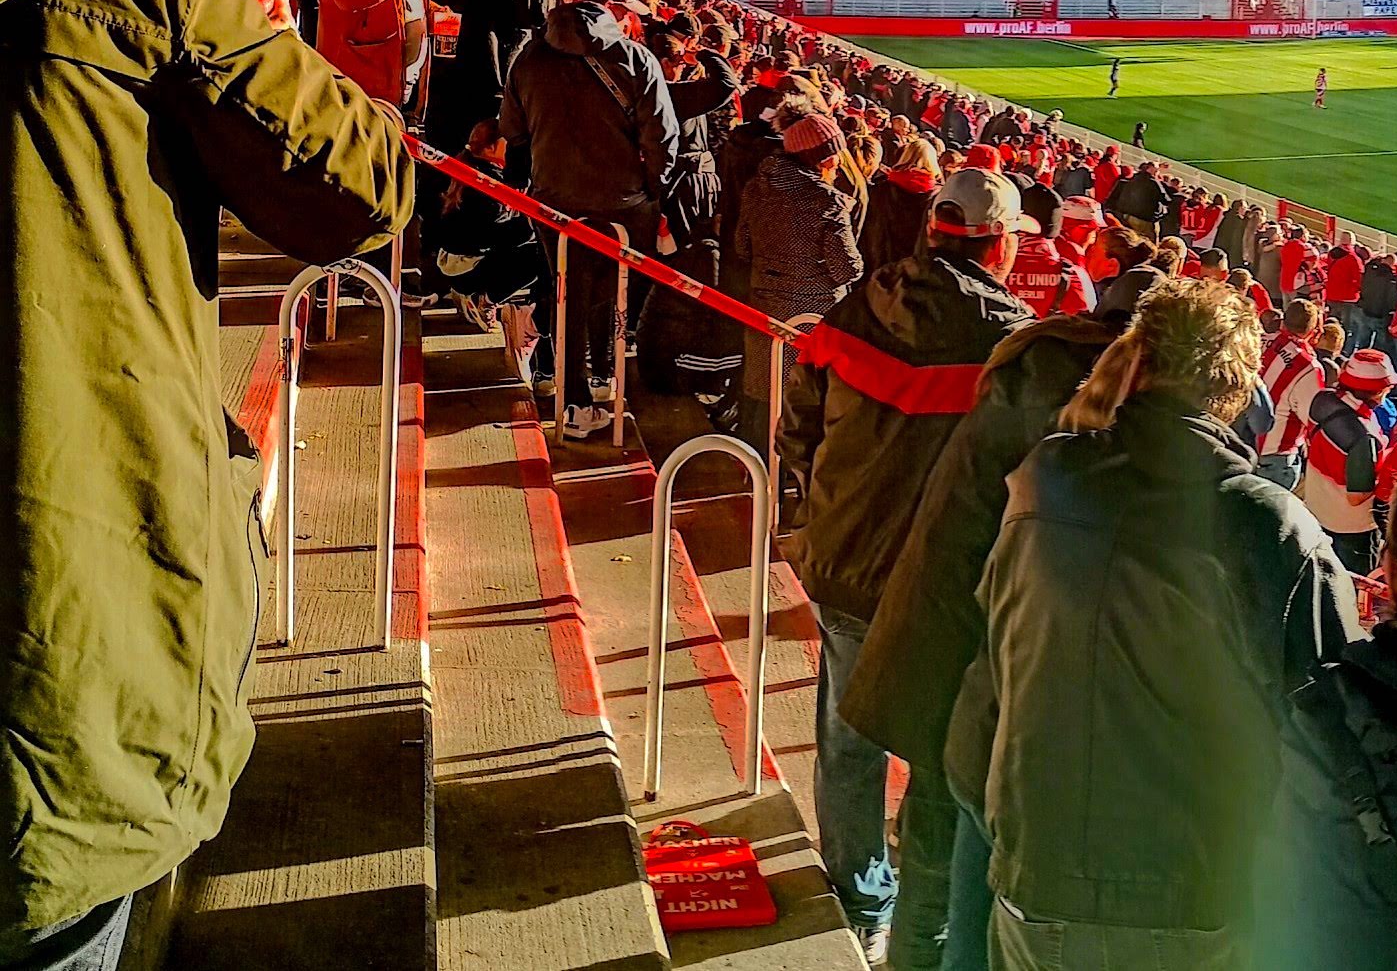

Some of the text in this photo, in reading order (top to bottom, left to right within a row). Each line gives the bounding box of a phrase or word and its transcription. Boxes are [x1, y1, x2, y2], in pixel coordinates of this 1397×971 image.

[964, 20, 1072, 37] www.proAF.berlin
[1009, 273, 1061, 286] FC UNIO
[663, 898, 739, 913] NICHT
